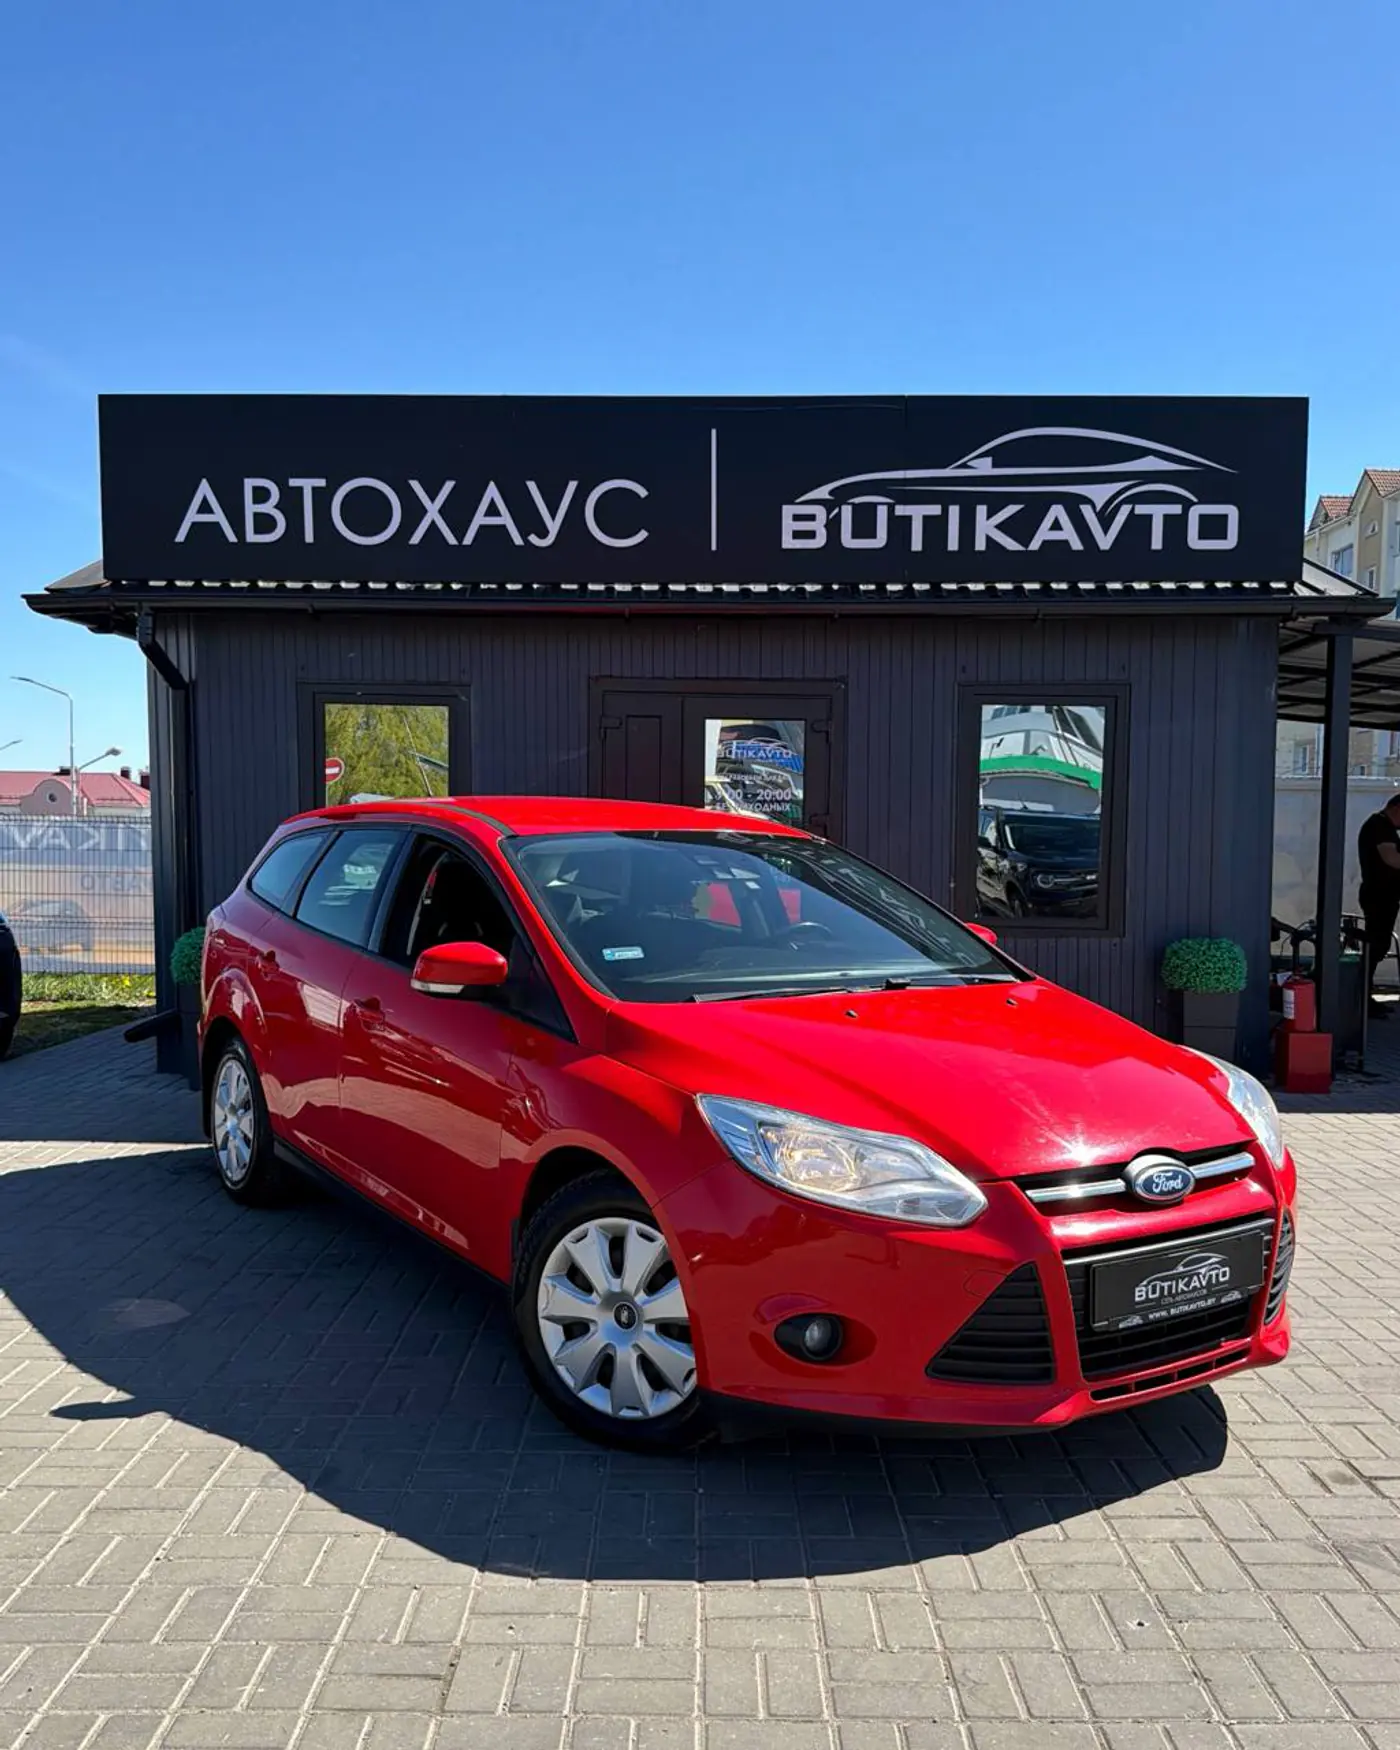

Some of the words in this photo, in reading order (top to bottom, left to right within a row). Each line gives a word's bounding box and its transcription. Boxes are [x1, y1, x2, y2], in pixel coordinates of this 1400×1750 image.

[174, 477, 649, 548] АВТОХАУС
[781, 503, 1240, 551] BUTIKAVTO
[1152, 1171, 1184, 1193] Ford
[1134, 1267, 1230, 1302] BUTIKAVTO
